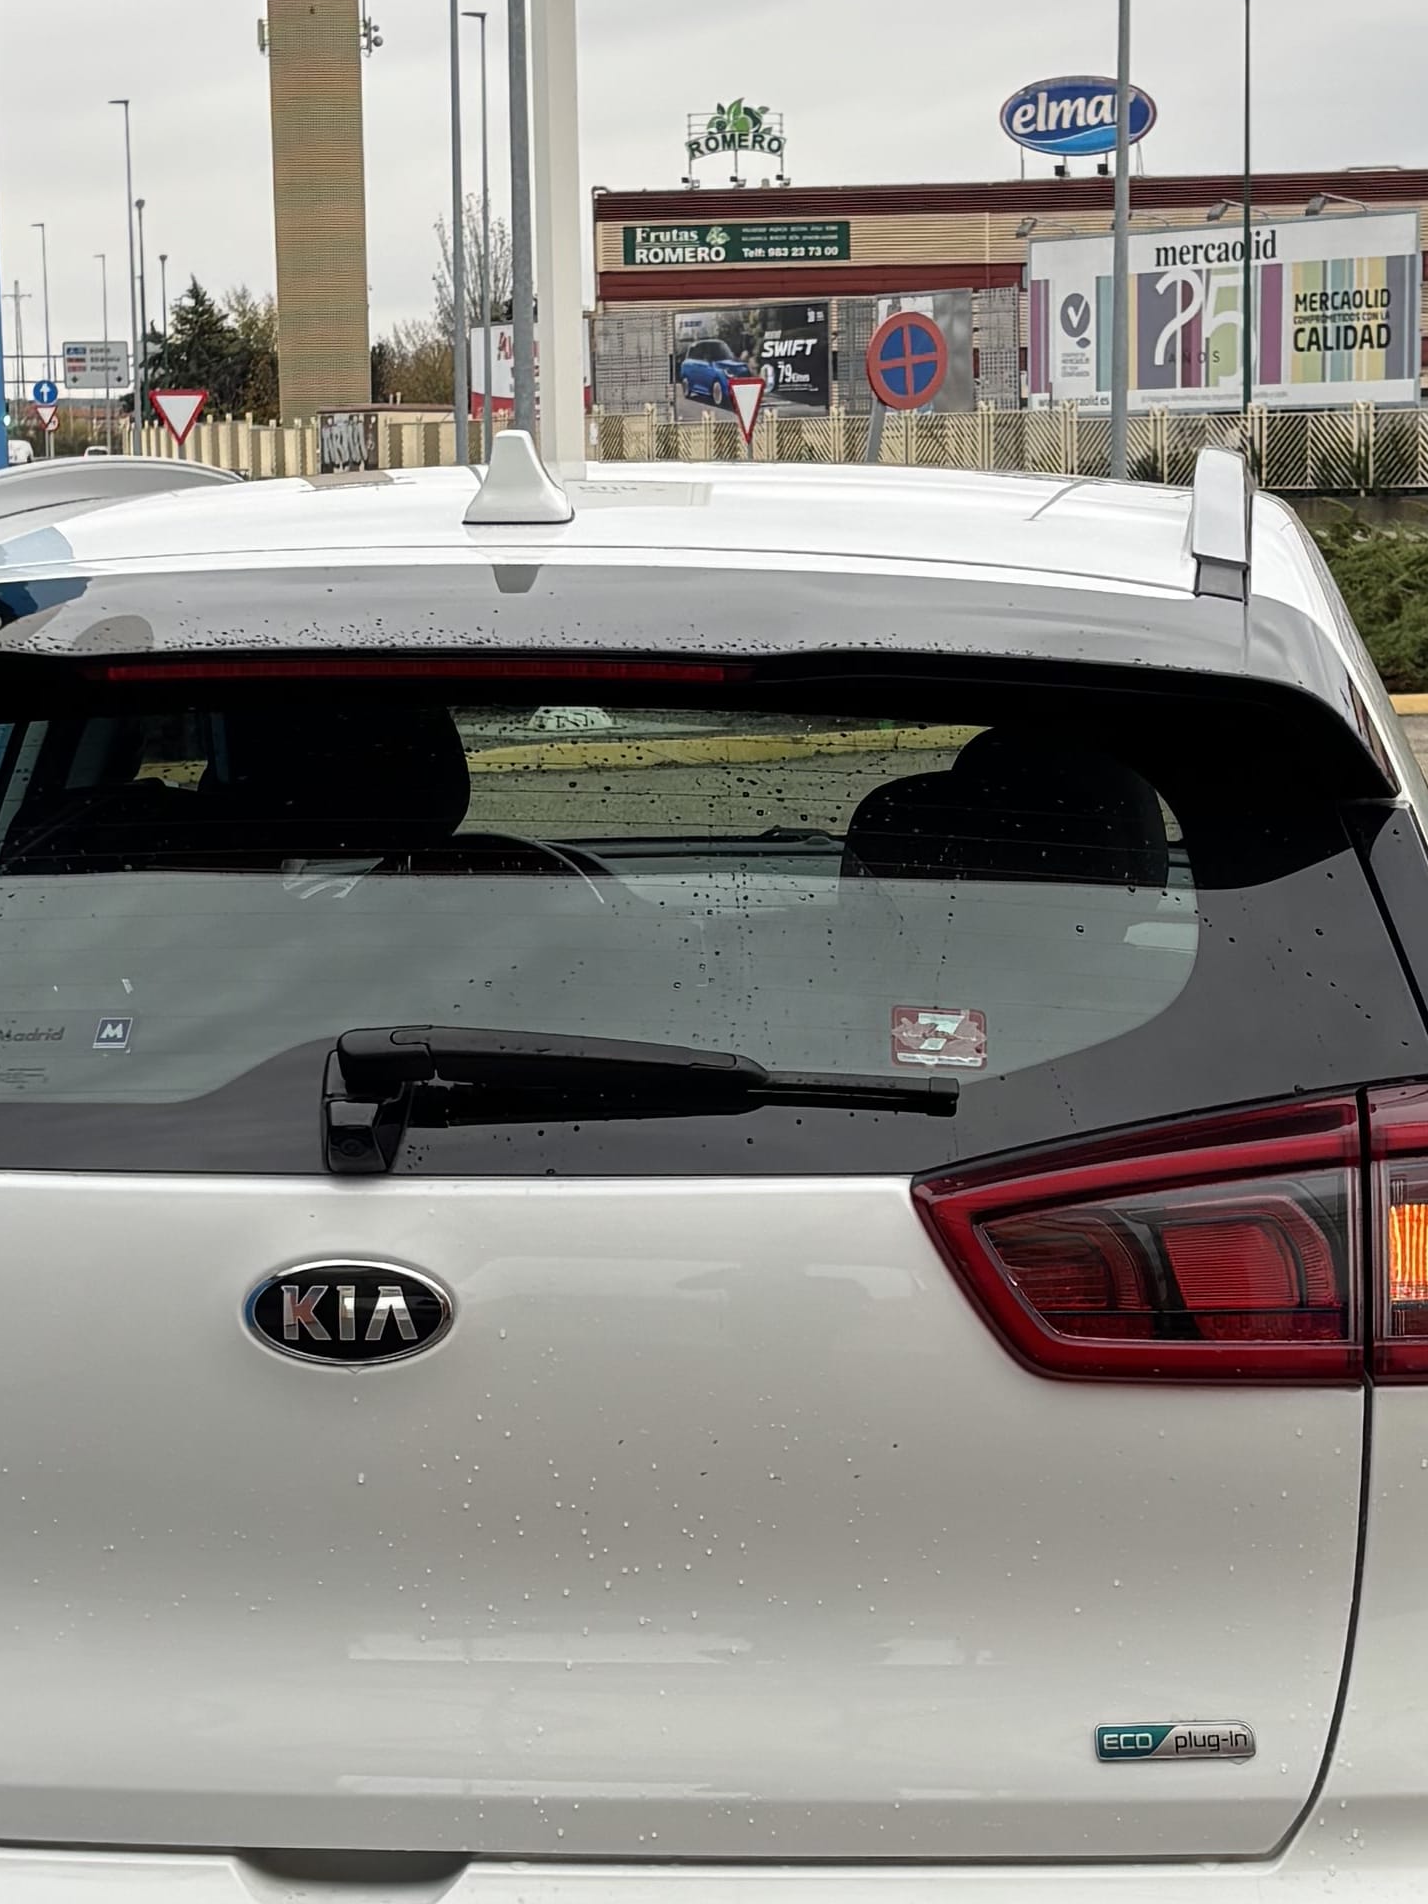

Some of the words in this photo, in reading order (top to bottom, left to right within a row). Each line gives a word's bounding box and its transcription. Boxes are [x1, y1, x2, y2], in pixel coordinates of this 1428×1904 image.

[688, 132, 783, 159] ROMERO
[635, 227, 699, 244] Frutas
[635, 246, 726, 265] ROMERO
[824, 246, 839, 256] 00
[1294, 288, 1391, 312] MERCAOLID
[761, 339, 818, 358] SWIFT
[1294, 324, 1391, 352] CALIDAD
[280, 1285, 419, 1341] KIA
[1103, 1732, 1153, 1751] ECO
[1174, 1730, 1248, 1754] plug-in
